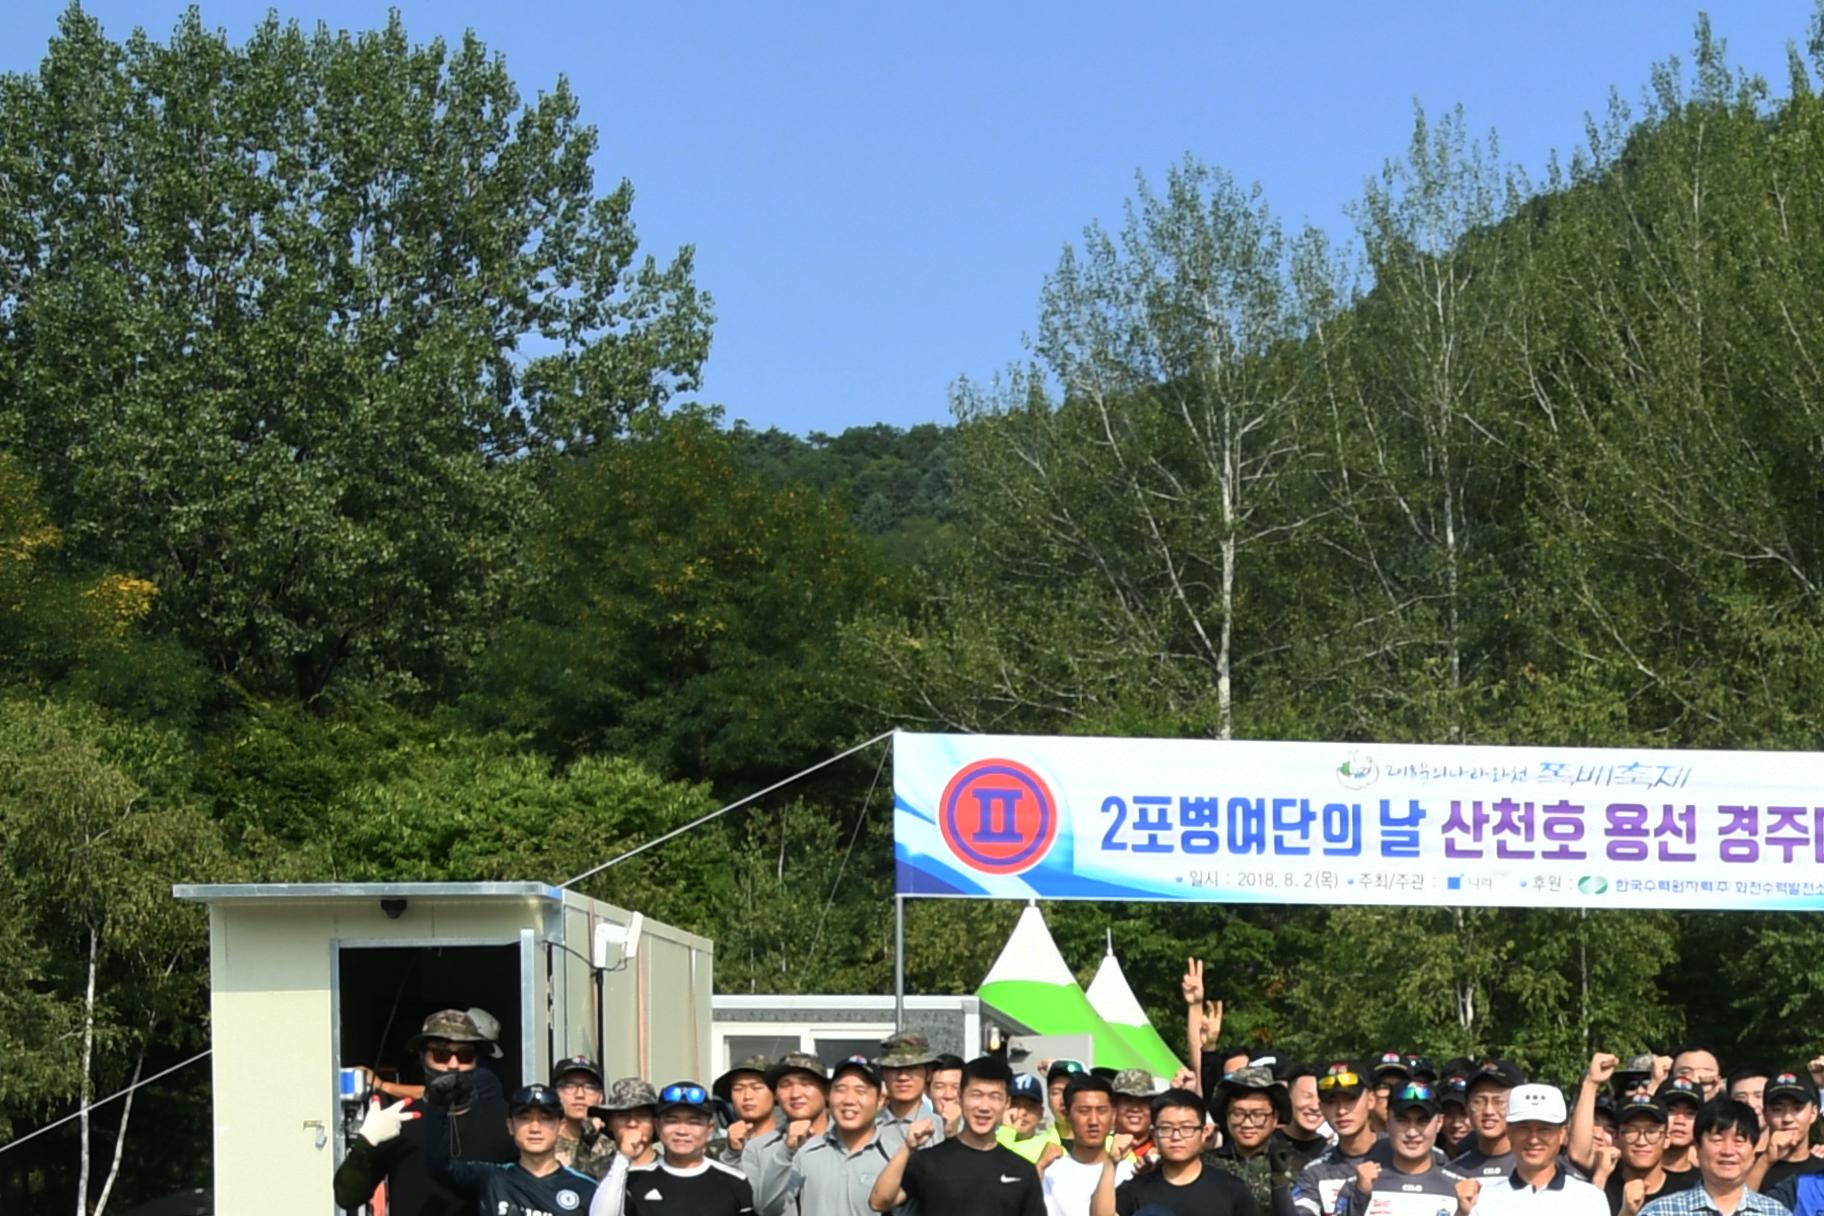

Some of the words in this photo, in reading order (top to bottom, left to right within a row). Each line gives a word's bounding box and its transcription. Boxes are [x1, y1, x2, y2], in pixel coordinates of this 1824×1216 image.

[1100, 795, 1362, 856] 2포병여단의
[1379, 798, 1427, 857] 날
[1441, 797, 1588, 860] 산천호
[1603, 803, 1697, 862] 용선
[1189, 869, 1219, 888] 일시
[1358, 871, 1425, 890] 주최/주관
[1531, 873, 1562, 892] 후원
